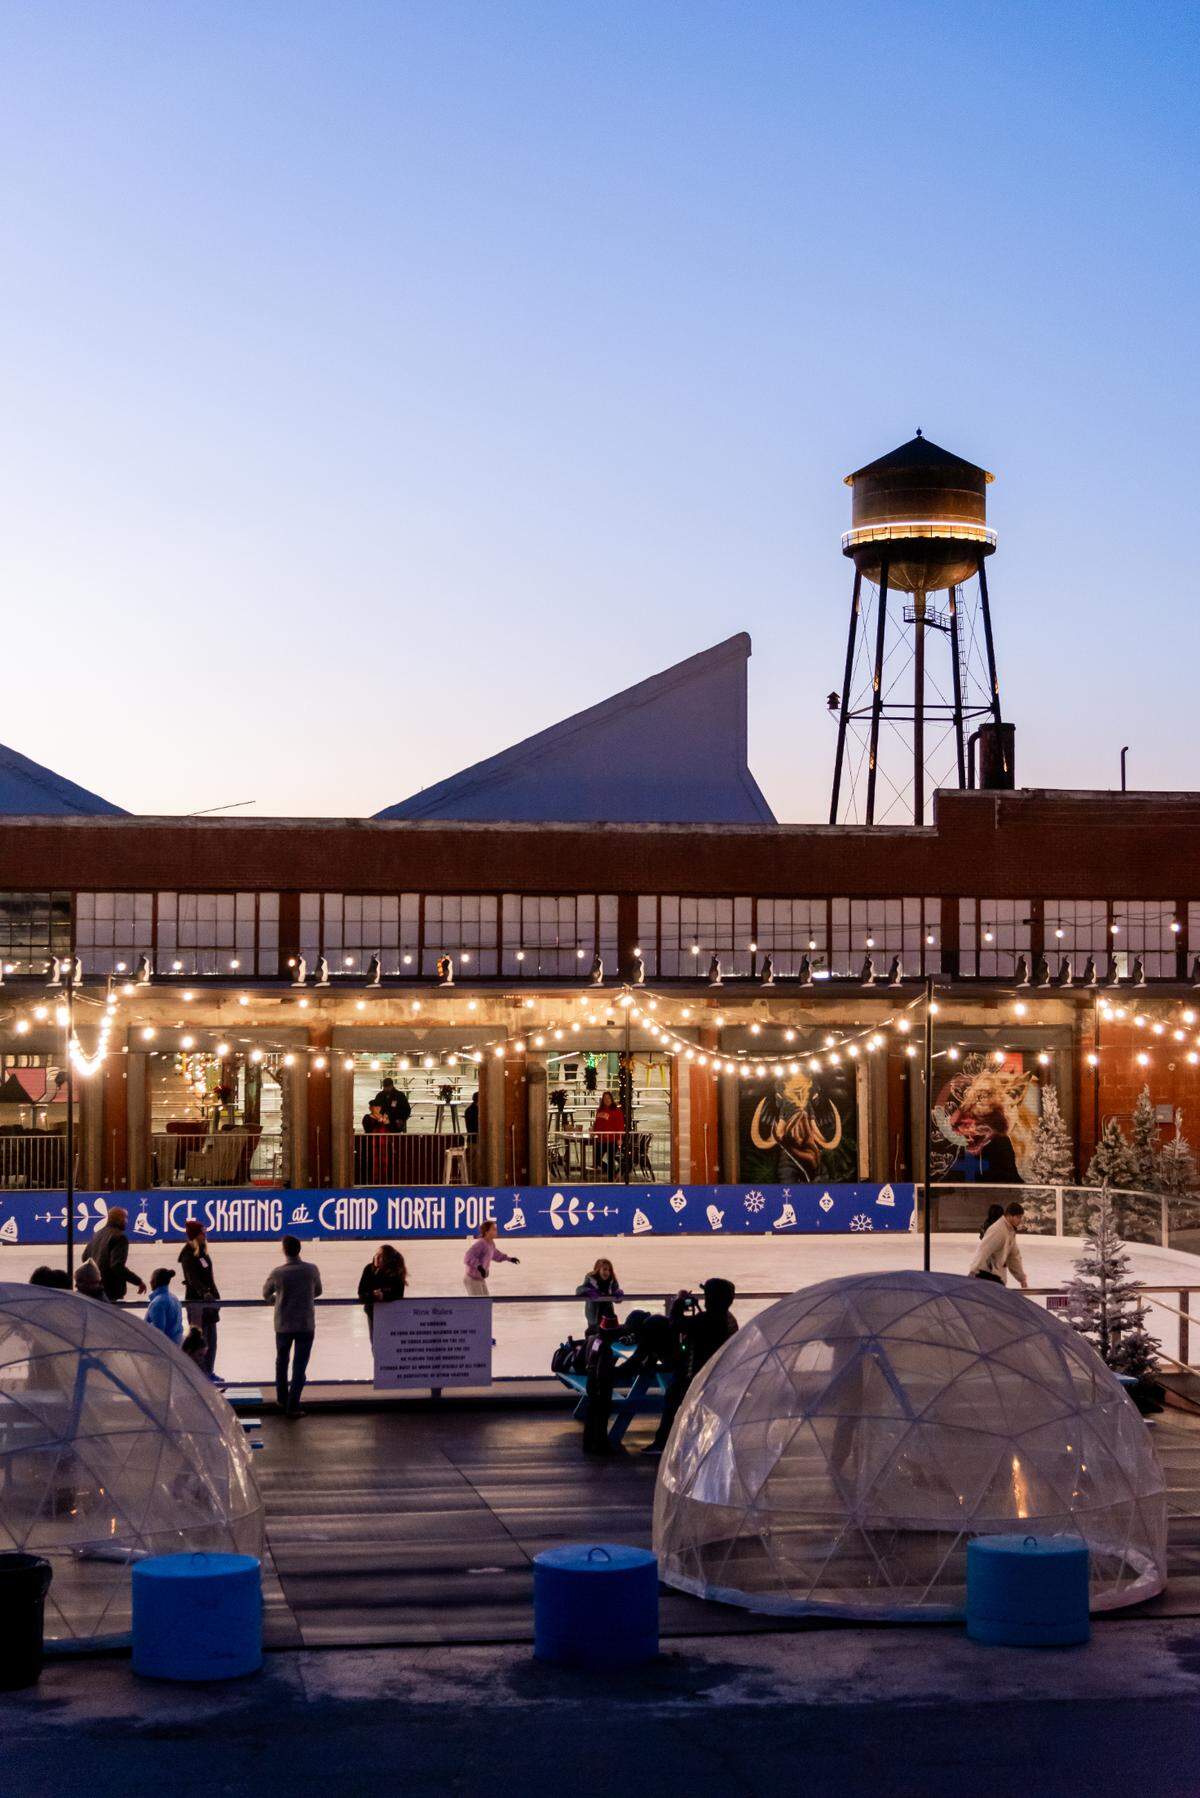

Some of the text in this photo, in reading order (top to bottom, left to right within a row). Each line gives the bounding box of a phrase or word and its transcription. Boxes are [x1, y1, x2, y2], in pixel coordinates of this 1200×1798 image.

[163, 1199, 198, 1233] ICE
[204, 1198, 283, 1232] SKATING
[289, 1203, 312, 1223] at
[318, 1197, 379, 1231] CAMP
[387, 1196, 446, 1230] NORTH
